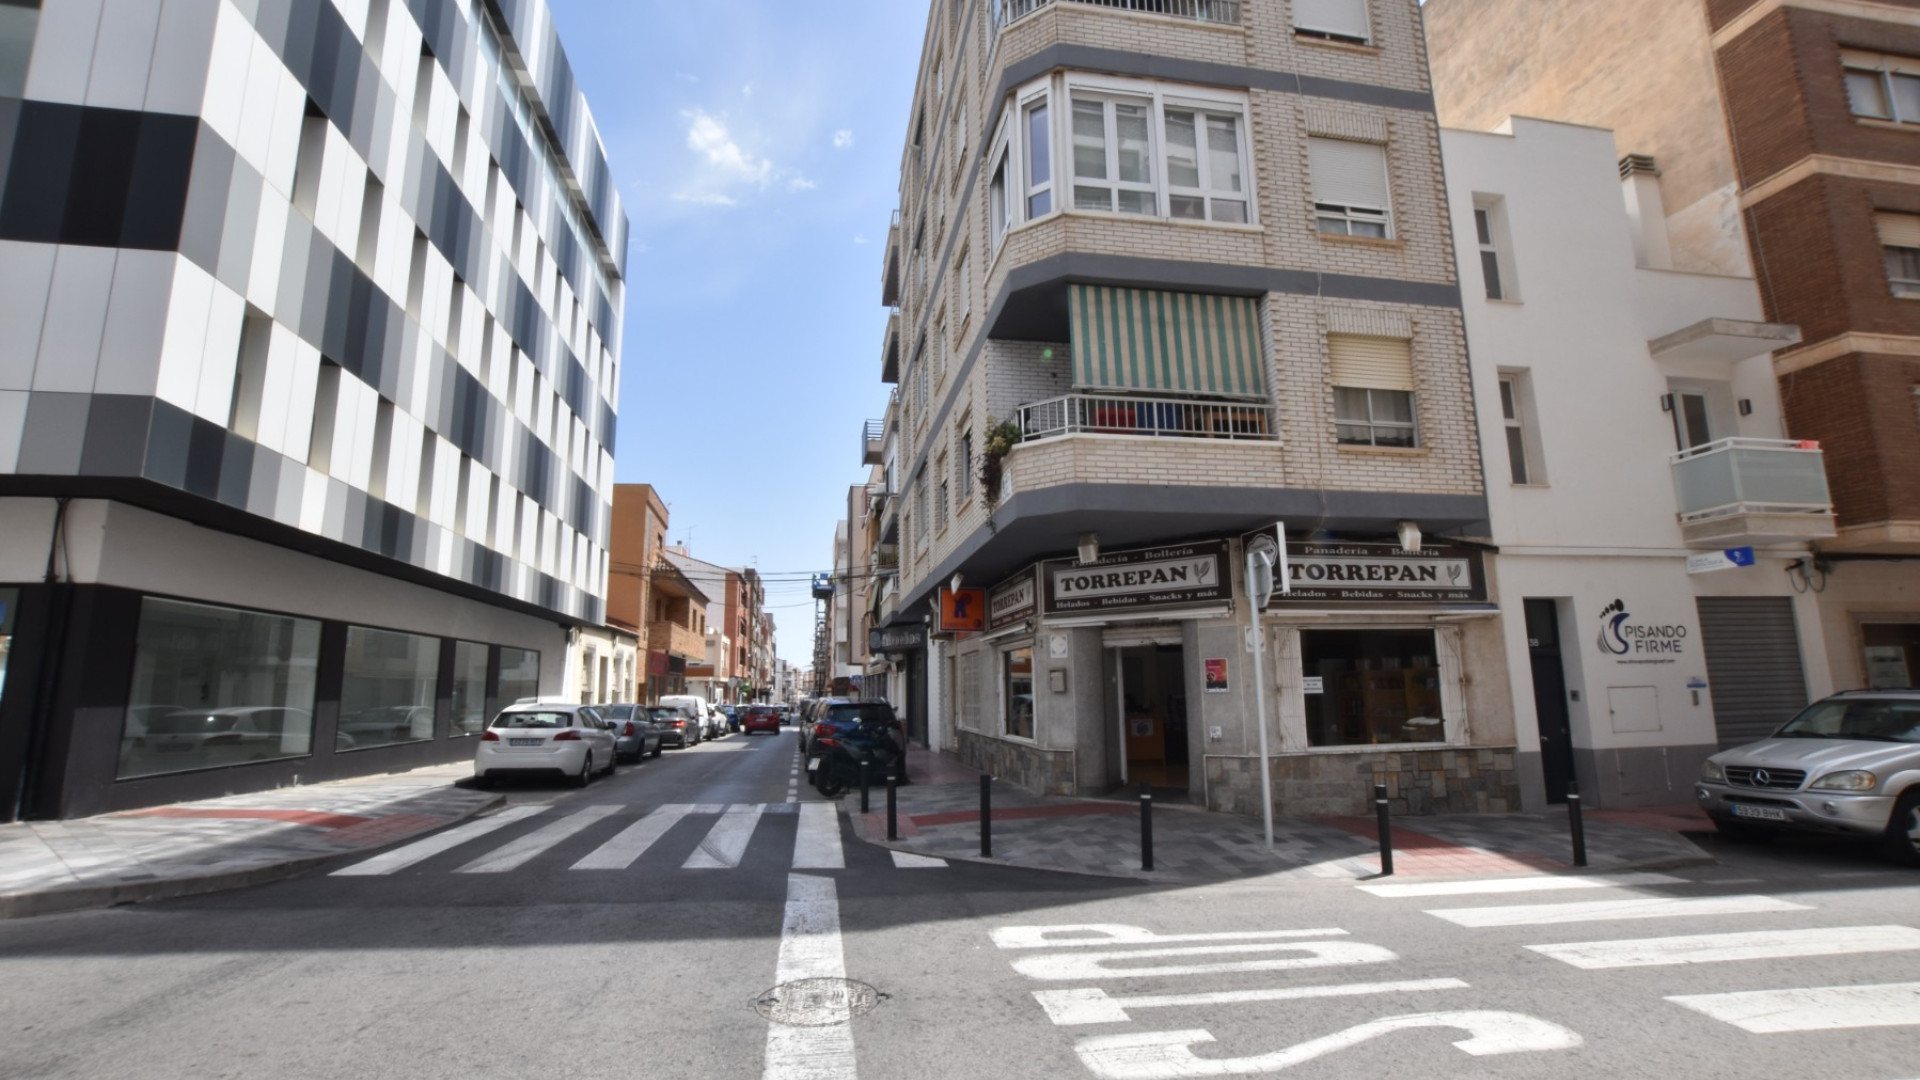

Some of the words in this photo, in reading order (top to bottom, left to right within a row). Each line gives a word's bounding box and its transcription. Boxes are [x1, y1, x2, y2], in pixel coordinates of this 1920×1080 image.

[1145, 547, 1194, 559] Bollería
[1304, 546, 1368, 555] Panadería
[1060, 566, 1188, 592] TORREPAN
[1288, 563, 1437, 581] TORREPAN
[1056, 600, 1090, 609] Helados
[1102, 596, 1137, 606] Bebidas
[1149, 592, 1182, 602] Snacks
[1197, 589, 1218, 598] más
[1341, 590, 1384, 598] Bebidas
[1397, 590, 1433, 598] Snacks
[1448, 590, 1469, 599] más
[1624, 625, 1687, 638] PISANDO
[1635, 639, 1682, 653] FIRME
[988, 922, 1583, 1079] STOP
